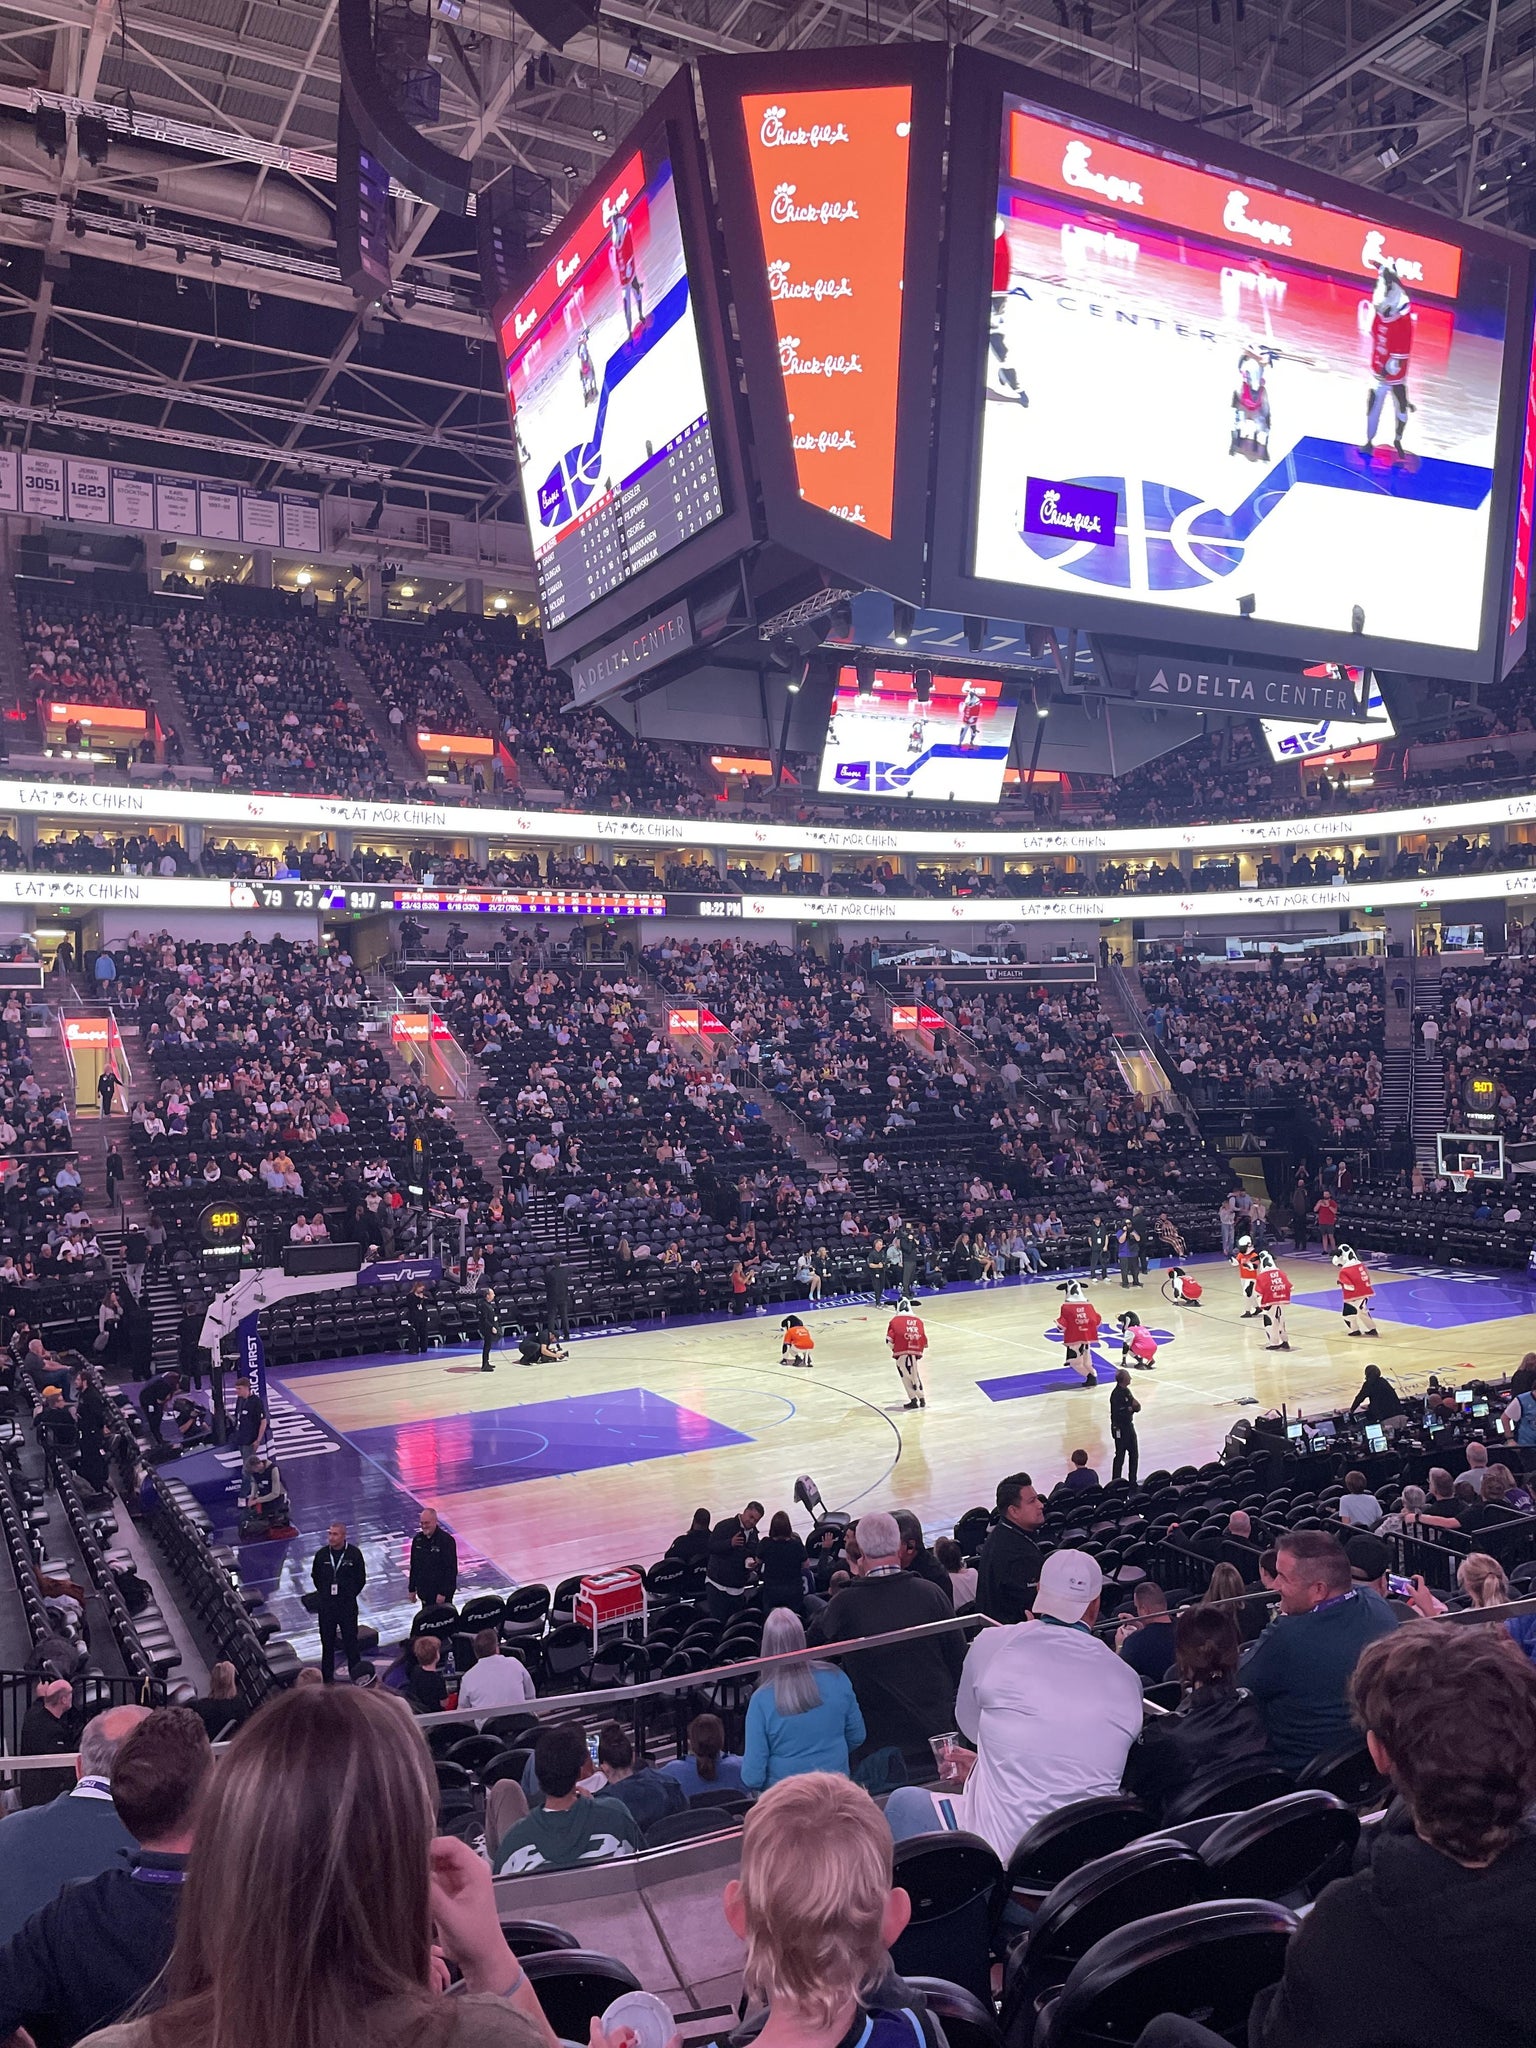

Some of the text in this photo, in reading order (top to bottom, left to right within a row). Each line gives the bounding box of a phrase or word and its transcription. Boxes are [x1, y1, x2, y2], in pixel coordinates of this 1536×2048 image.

[760, 106, 848, 147] Chick-fil-A
[771, 183, 857, 223] Chick-fil-A
[793, 430, 856, 452] ick-fil-A
[621, 483, 641, 504] KESSLER
[687, 442, 692, 453] 2
[704, 428, 709, 439] 2
[25, 476, 60, 492] 3051
[71, 482, 106, 498] 1223
[117, 488, 149, 498] STOCKTON
[686, 504, 692, 514] 2
[712, 485, 718, 495] 0
[626, 518, 645, 538] GEORGE
[710, 466, 715, 477] 2
[689, 522, 694, 532] 2
[715, 504, 720, 514] 0
[588, 615, 687, 686] DELTA CENTER
[1177, 672, 1346, 711] DELTA CENTER
[92, 792, 143, 809] CHIKIN
[373, 808, 401, 823] MOR
[404, 810, 446, 826] CHIKIN
[647, 823, 683, 837] CHIKIN
[1313, 821, 1353, 834] CHIKIN
[865, 834, 897, 847] CHIKIN
[1071, 836, 1106, 848] CHIKIN
[88, 883, 140, 900] CHIKIN
[262, 889, 376, 909] 79 73 9:07
[1311, 892, 1350, 904] CHIKIN
[401, 902, 421, 910] 23/43
[726, 901, 742, 917] PM
[863, 904, 896, 916] CHIKIN
[1069, 903, 1104, 915] CHIKIN
[1473, 1080, 1493, 1093] 9:07
[212, 1213, 239, 1227] 9:07
[248, 1335, 258, 1370] FIRST
